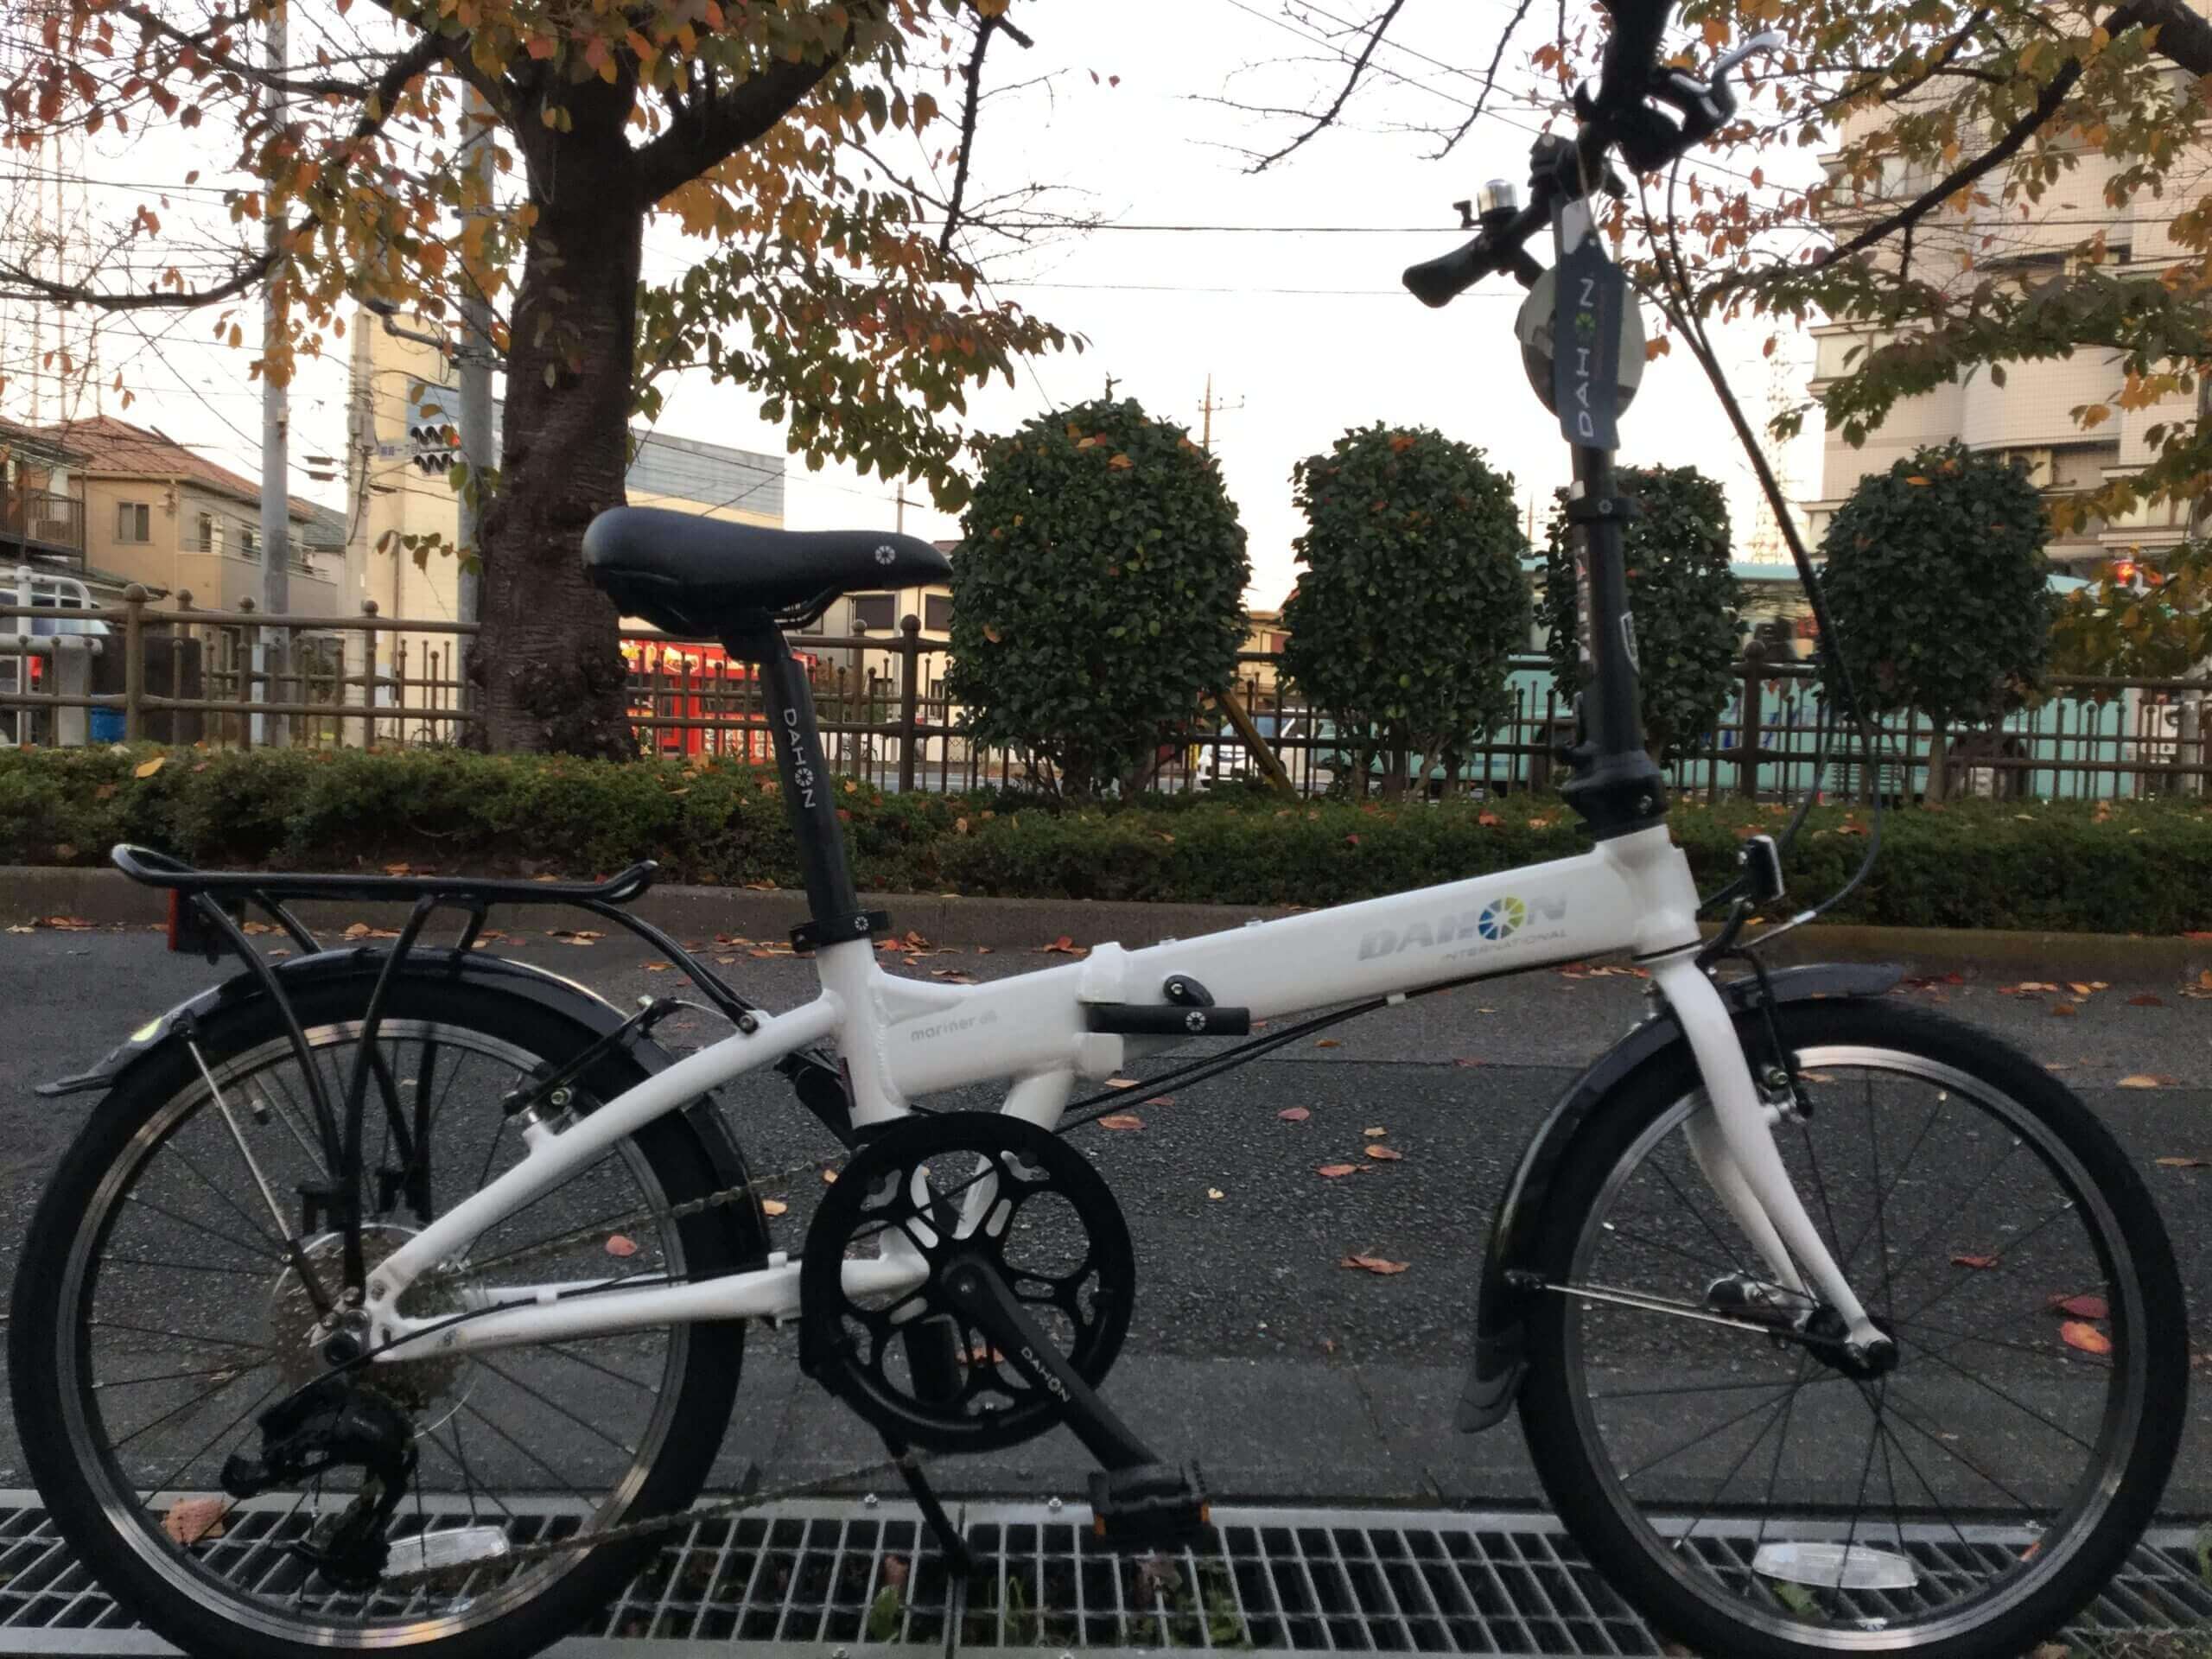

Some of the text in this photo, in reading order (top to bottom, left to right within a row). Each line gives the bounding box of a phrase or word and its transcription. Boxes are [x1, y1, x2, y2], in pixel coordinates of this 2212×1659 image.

[1575, 277, 1596, 438] DAHON
[784, 708, 817, 809] DAHON
[1357, 895, 1568, 961] DAHON
[911, 1016, 976, 1041] mariner
[1020, 1345, 1071, 1402] DAHON
